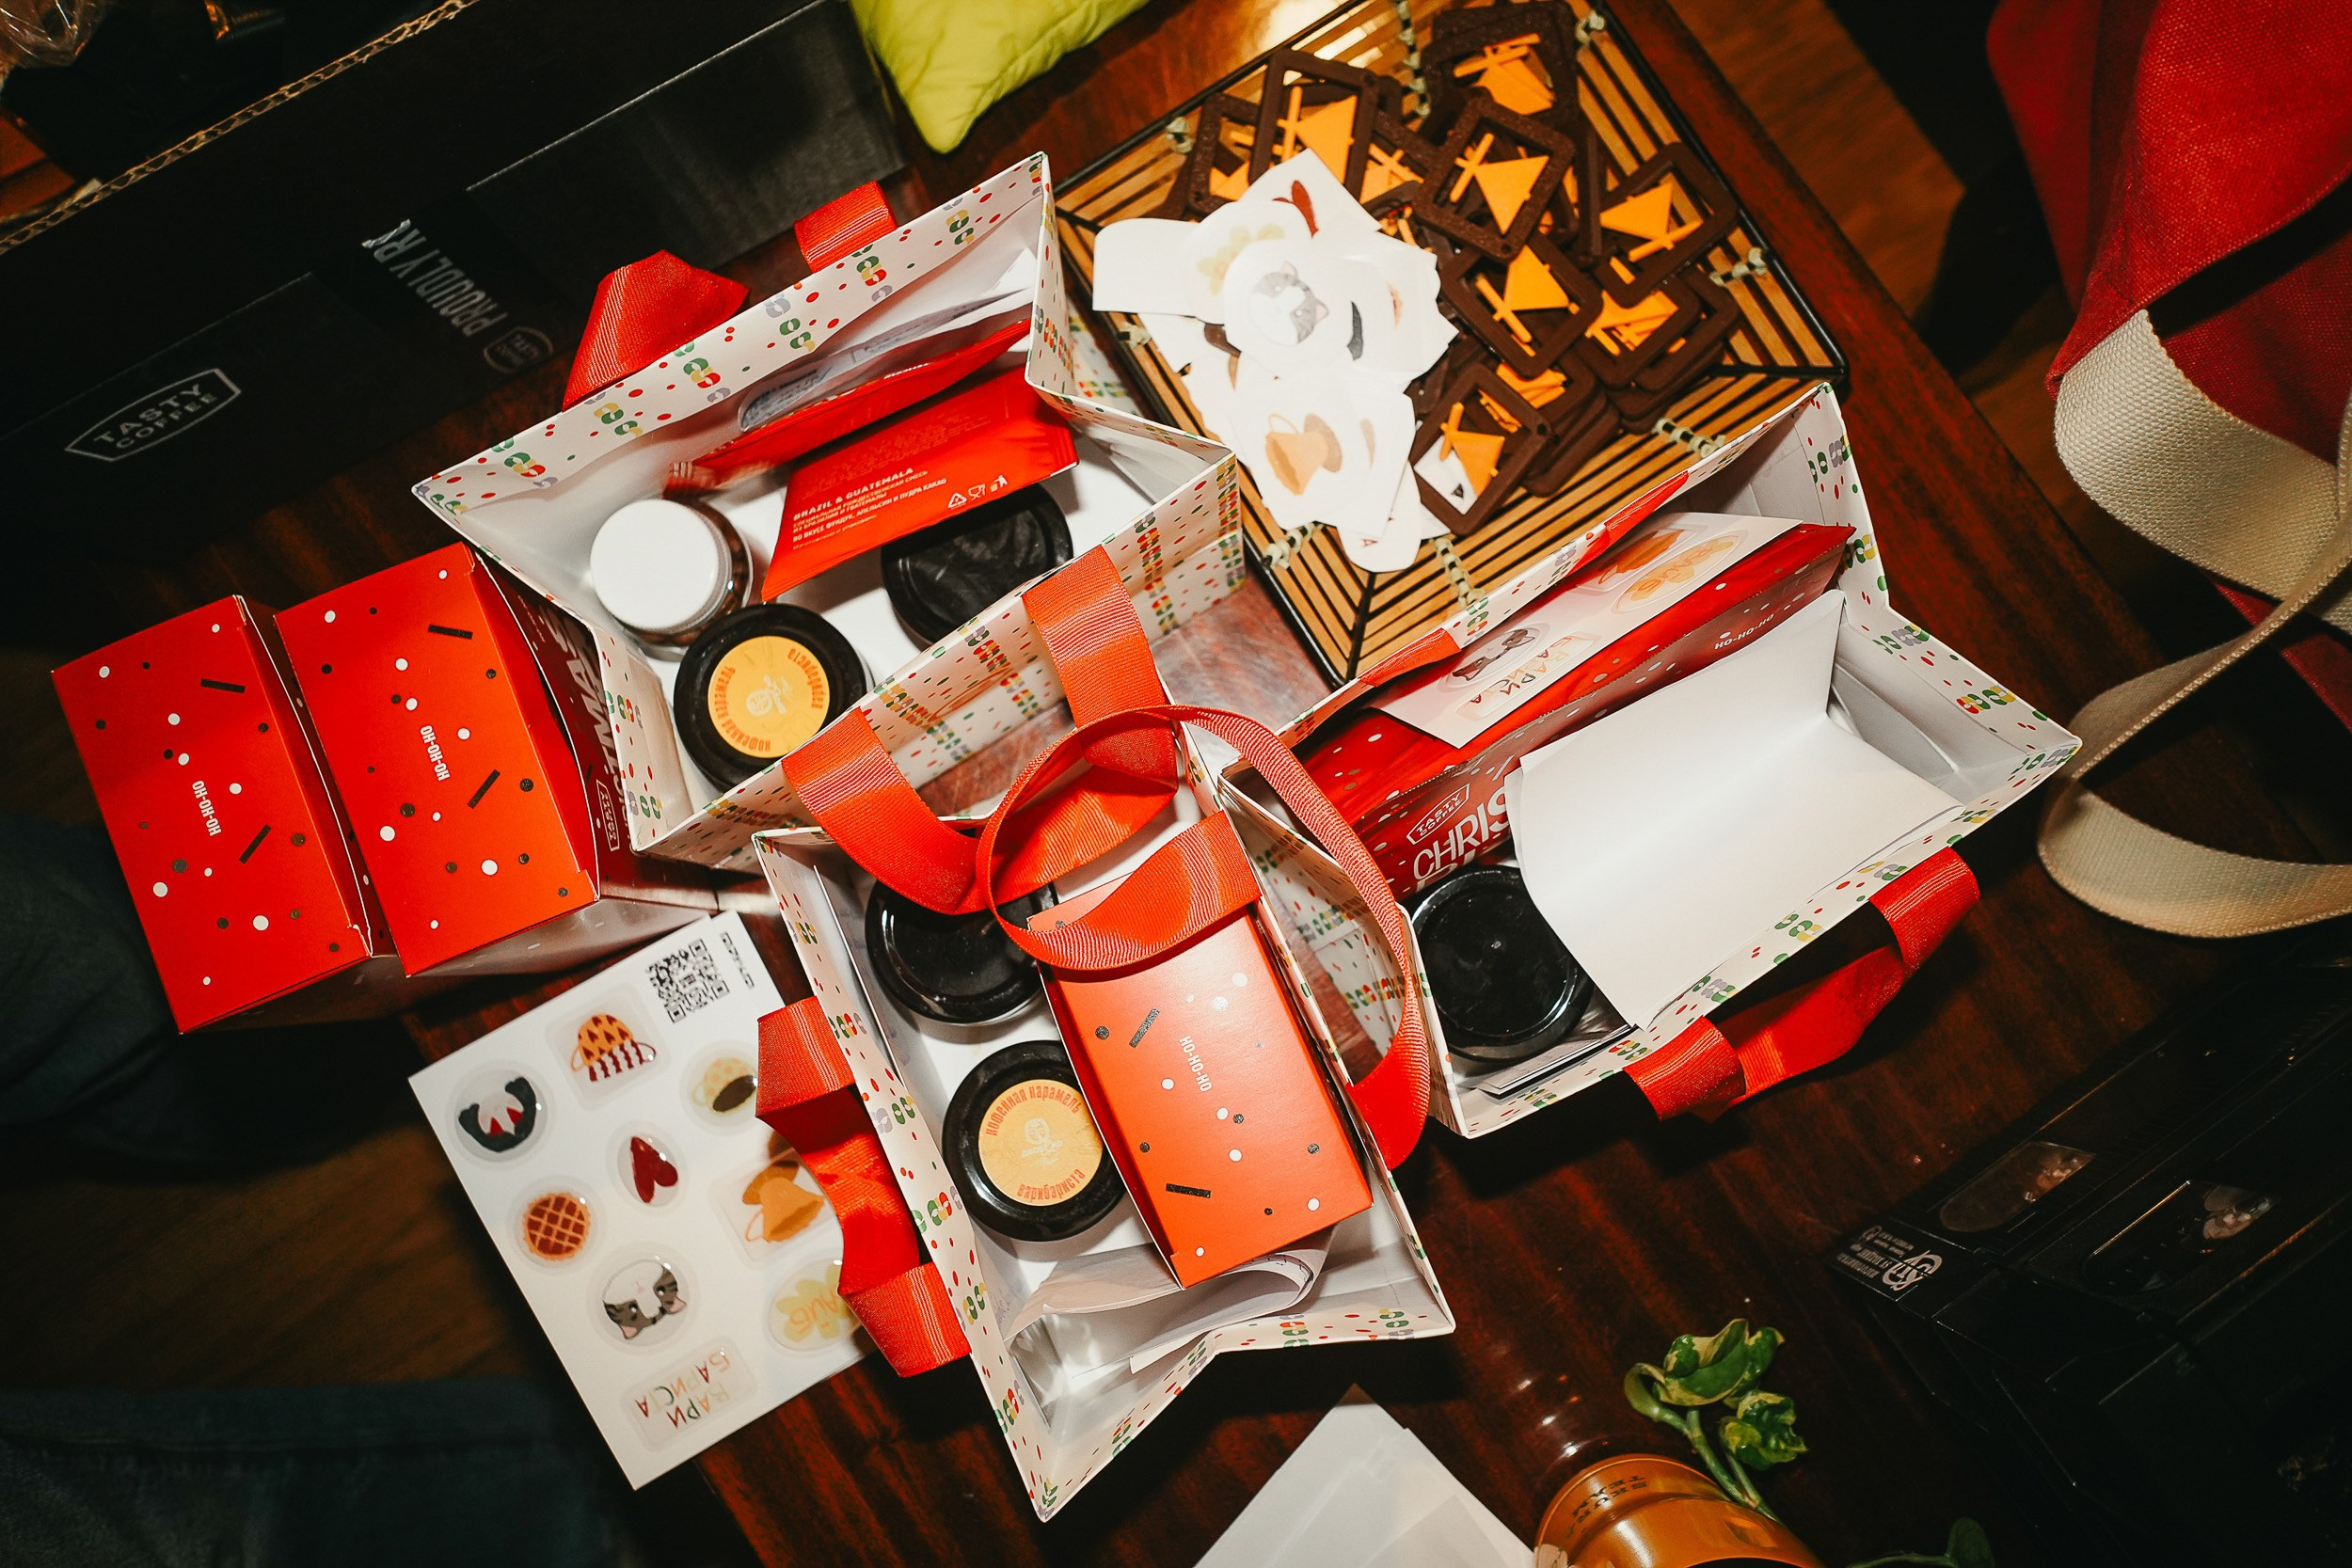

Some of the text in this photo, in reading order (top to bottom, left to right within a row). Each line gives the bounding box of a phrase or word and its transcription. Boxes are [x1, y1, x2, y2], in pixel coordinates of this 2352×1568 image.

[389, 249, 509, 338] PROUDLY
[93, 384, 201, 443] TASTY
[116, 392, 217, 449] COFFEE
[793, 499, 832, 520] BRAZIL
[846, 467, 914, 499] GUATEMALA
[856, 497, 893, 516] АПЕЛЬСИН
[923, 477, 946, 491] КАКАО
[1715, 613, 1773, 649] HO-HO-HO
[420, 725, 451, 782] HO-HO-HO
[192, 780, 222, 836] HO-HO-HO
[1413, 785, 1510, 880] CHRIS
[1416, 794, 1459, 832] TASTY
[1419, 801, 1462, 835] COFFEE
[1179, 1035, 1213, 1092] HO-HO-HO
[985, 1085, 1083, 1136] кофейная карамель
[1017, 1168, 1087, 1201] варибариста
[786, 1284, 839, 1334] АЙБ
[633, 1348, 732, 1417] БАРИСТА
[665, 1382, 731, 1430] ВАРИ
[1571, 1475, 1645, 1517] TEAM
